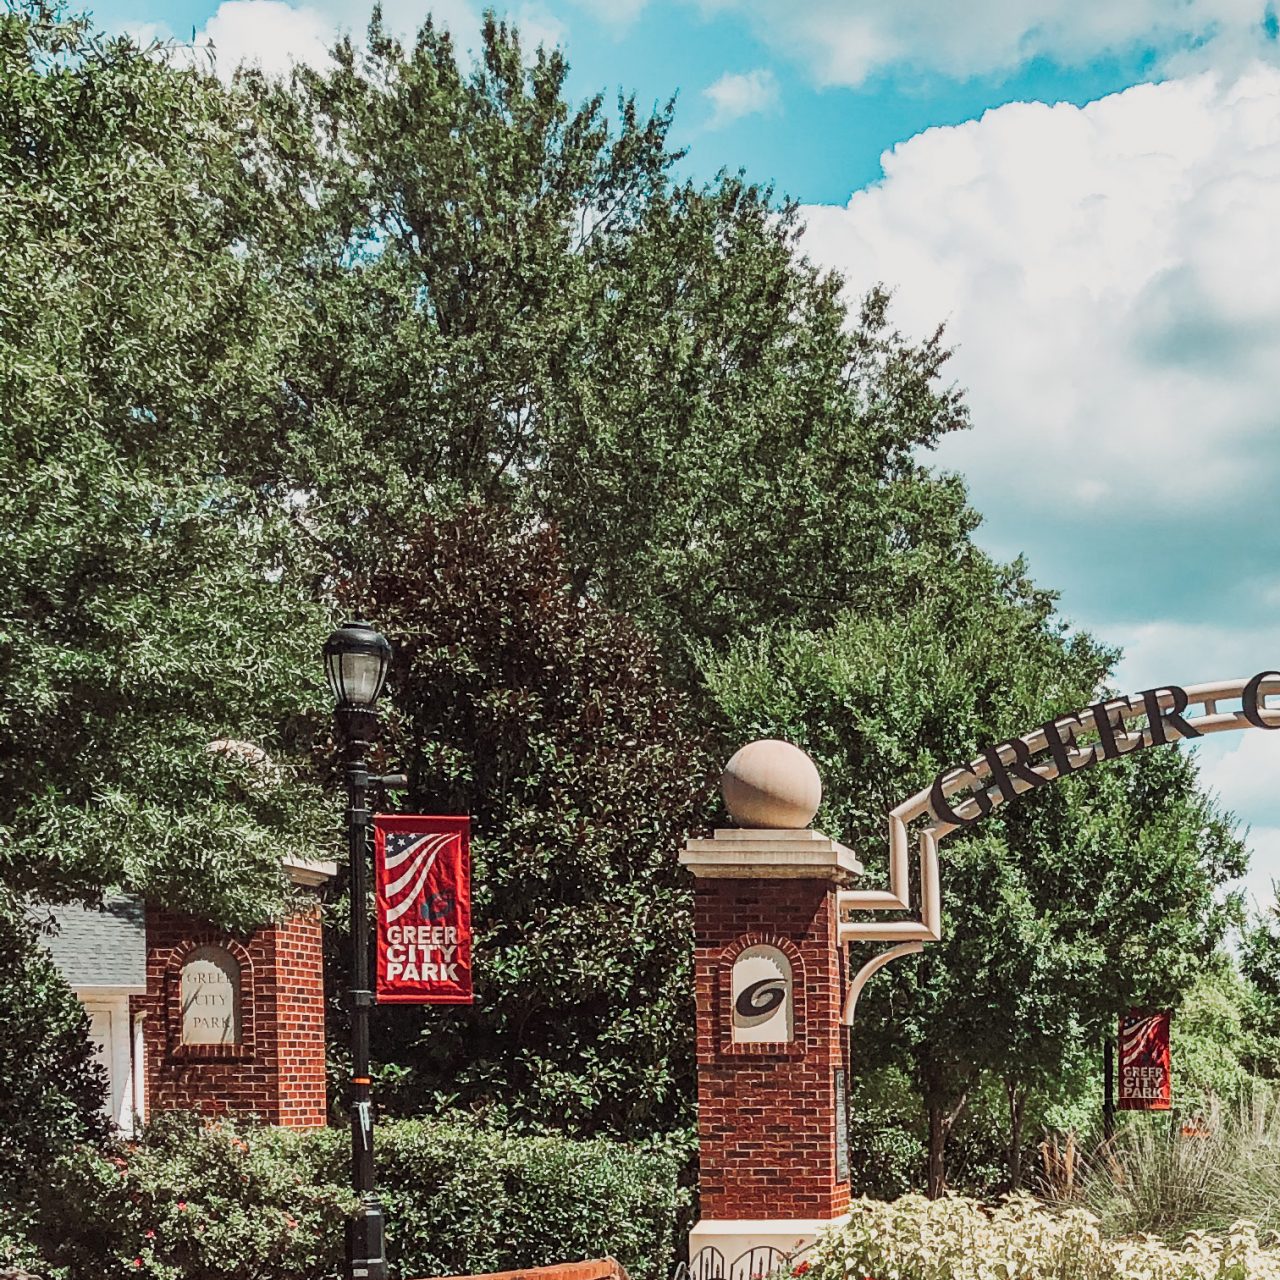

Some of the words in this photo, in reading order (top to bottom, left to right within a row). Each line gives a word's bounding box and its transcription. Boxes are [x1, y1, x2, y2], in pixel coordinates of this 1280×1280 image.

[930, 685, 1205, 824] GREER
[386, 926, 458, 945] GREER
[386, 944, 457, 963] CITY
[386, 963, 460, 981] PARK
[194, 994, 226, 1006] CITY
[1123, 1066, 1163, 1078] GREER
[1123, 1077, 1162, 1087] CITY
[1123, 1087, 1163, 1098] PARK
